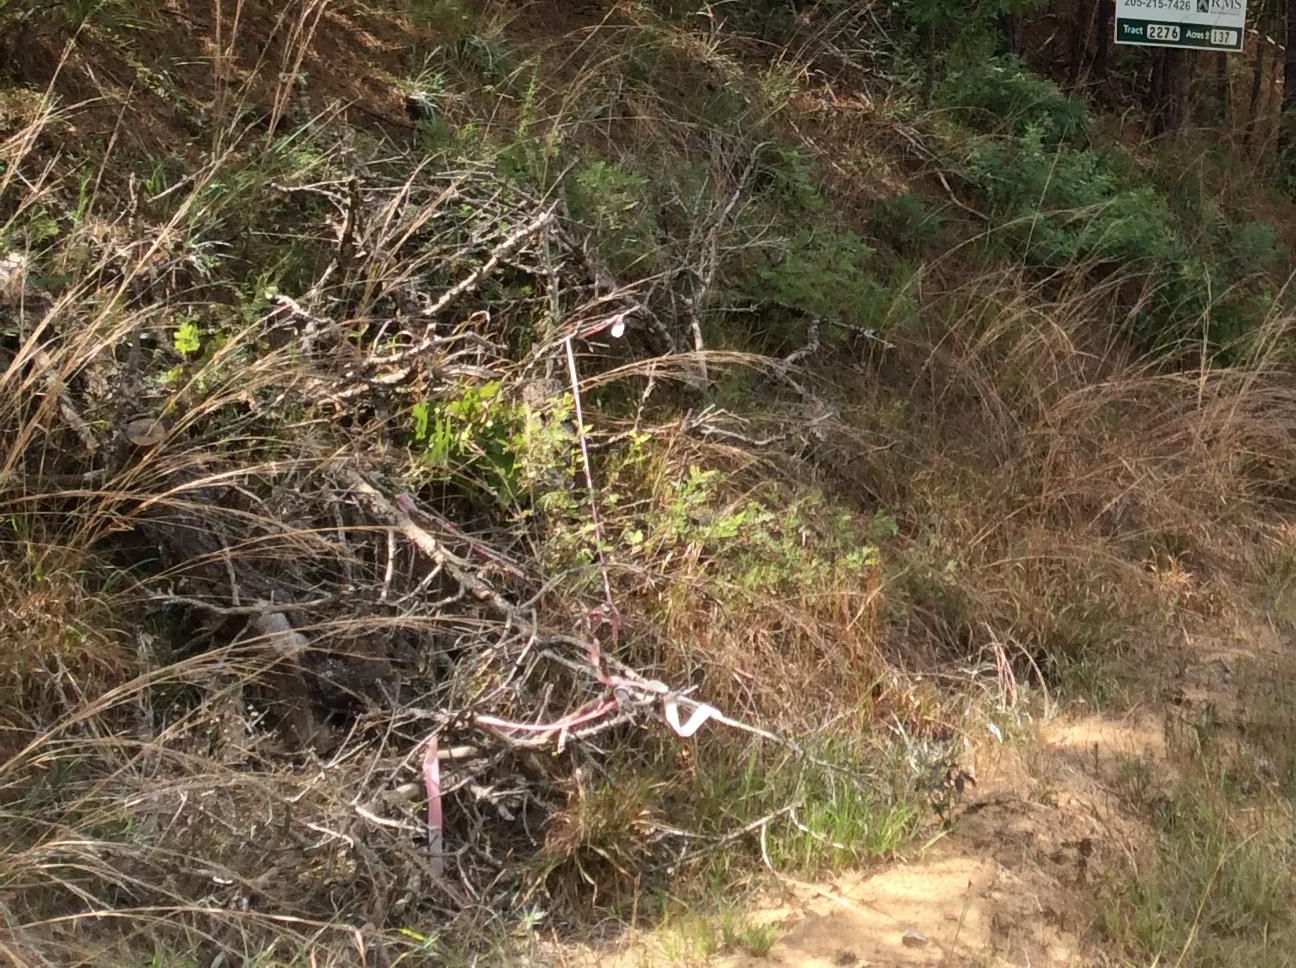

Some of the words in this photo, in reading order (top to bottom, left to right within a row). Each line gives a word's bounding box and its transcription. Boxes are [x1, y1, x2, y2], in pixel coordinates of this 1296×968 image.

[1123, 25, 1143, 35] Tract
[1149, 26, 1178, 40] 2276
[1213, 31, 1230, 44] 137
